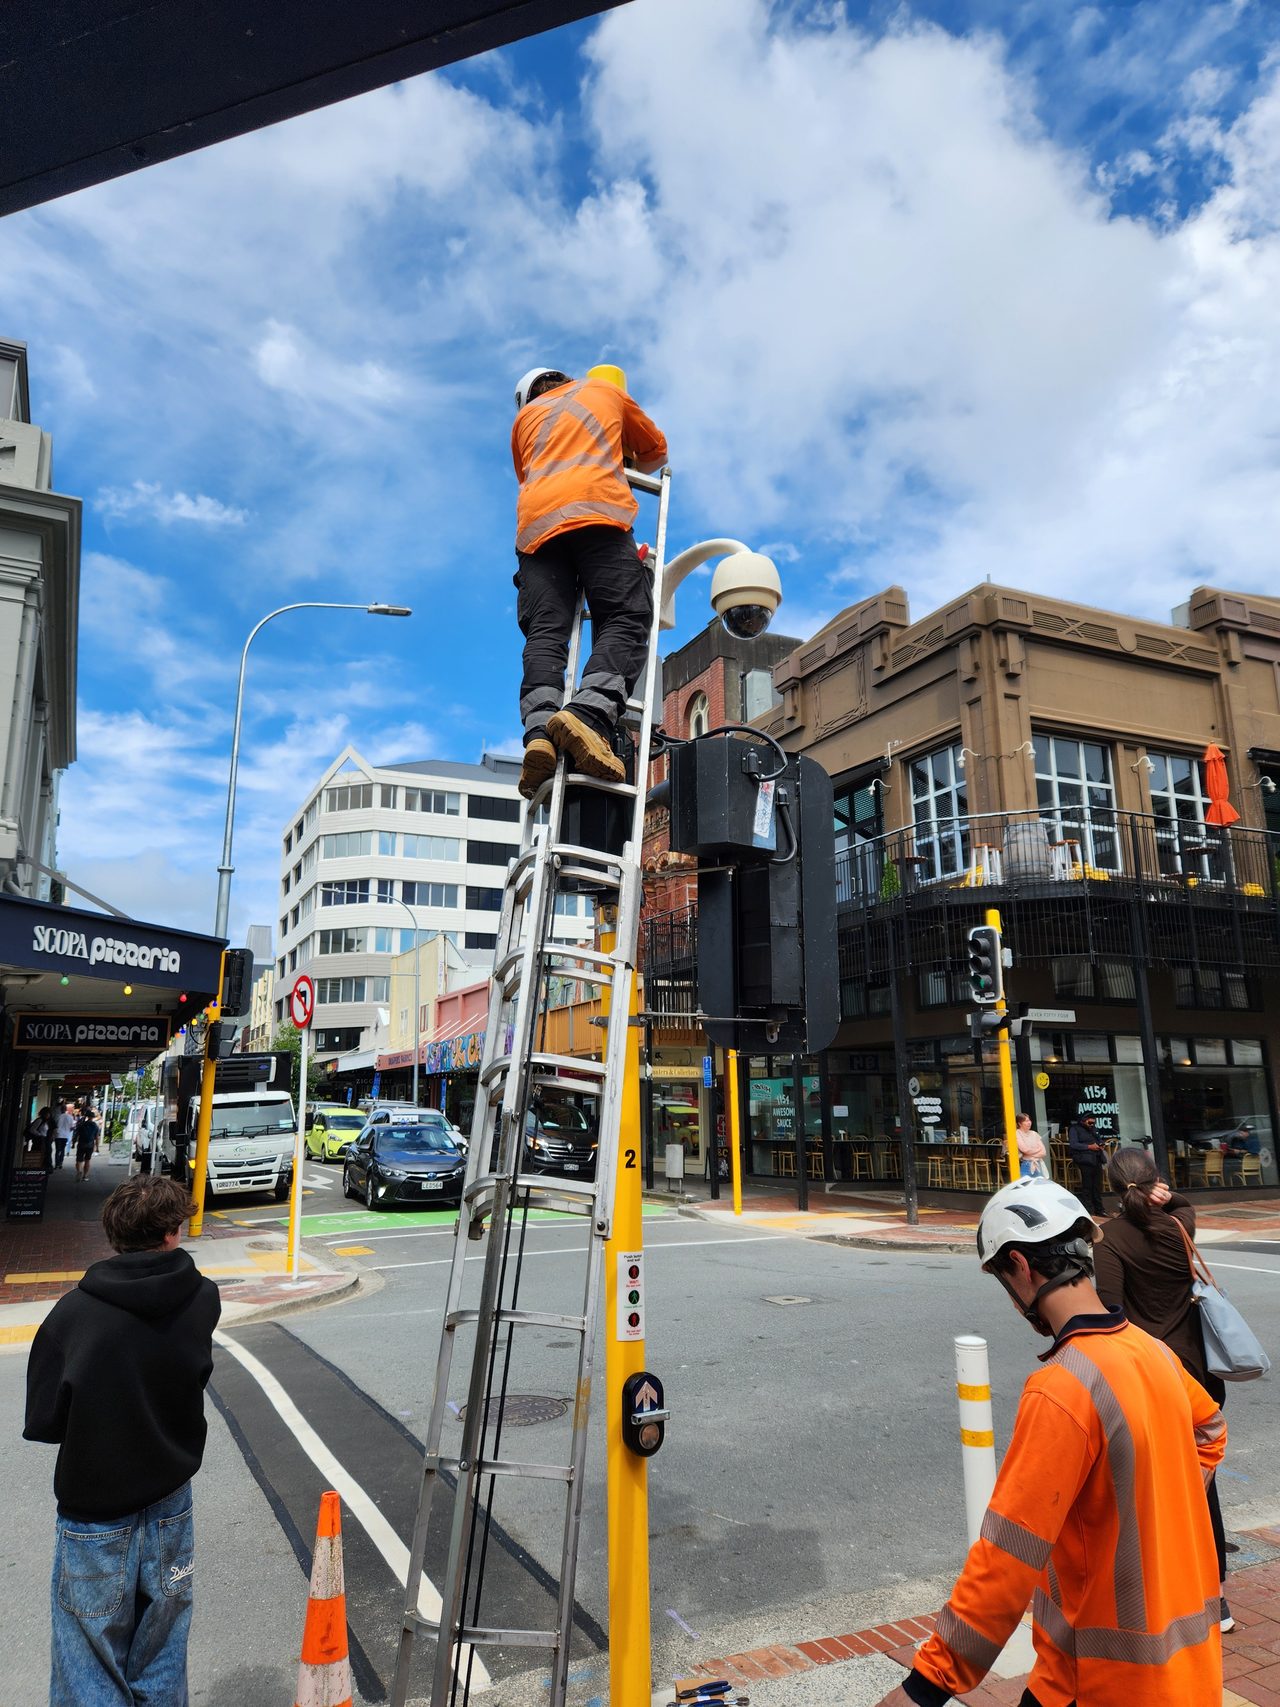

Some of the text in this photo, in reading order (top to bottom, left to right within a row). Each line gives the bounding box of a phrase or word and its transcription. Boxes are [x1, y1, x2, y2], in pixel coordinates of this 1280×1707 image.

[33, 925, 181, 974] SCOPA pizzeria
[26, 1023, 159, 1043] SCOPA pizzeria
[1084, 1085, 1107, 1099] 1154
[1078, 1102, 1120, 1114] AWESOME
[777, 1118, 792, 1128] SAUCE
[1095, 1117, 1113, 1129] UCE
[625, 1149, 636, 1168] 2
